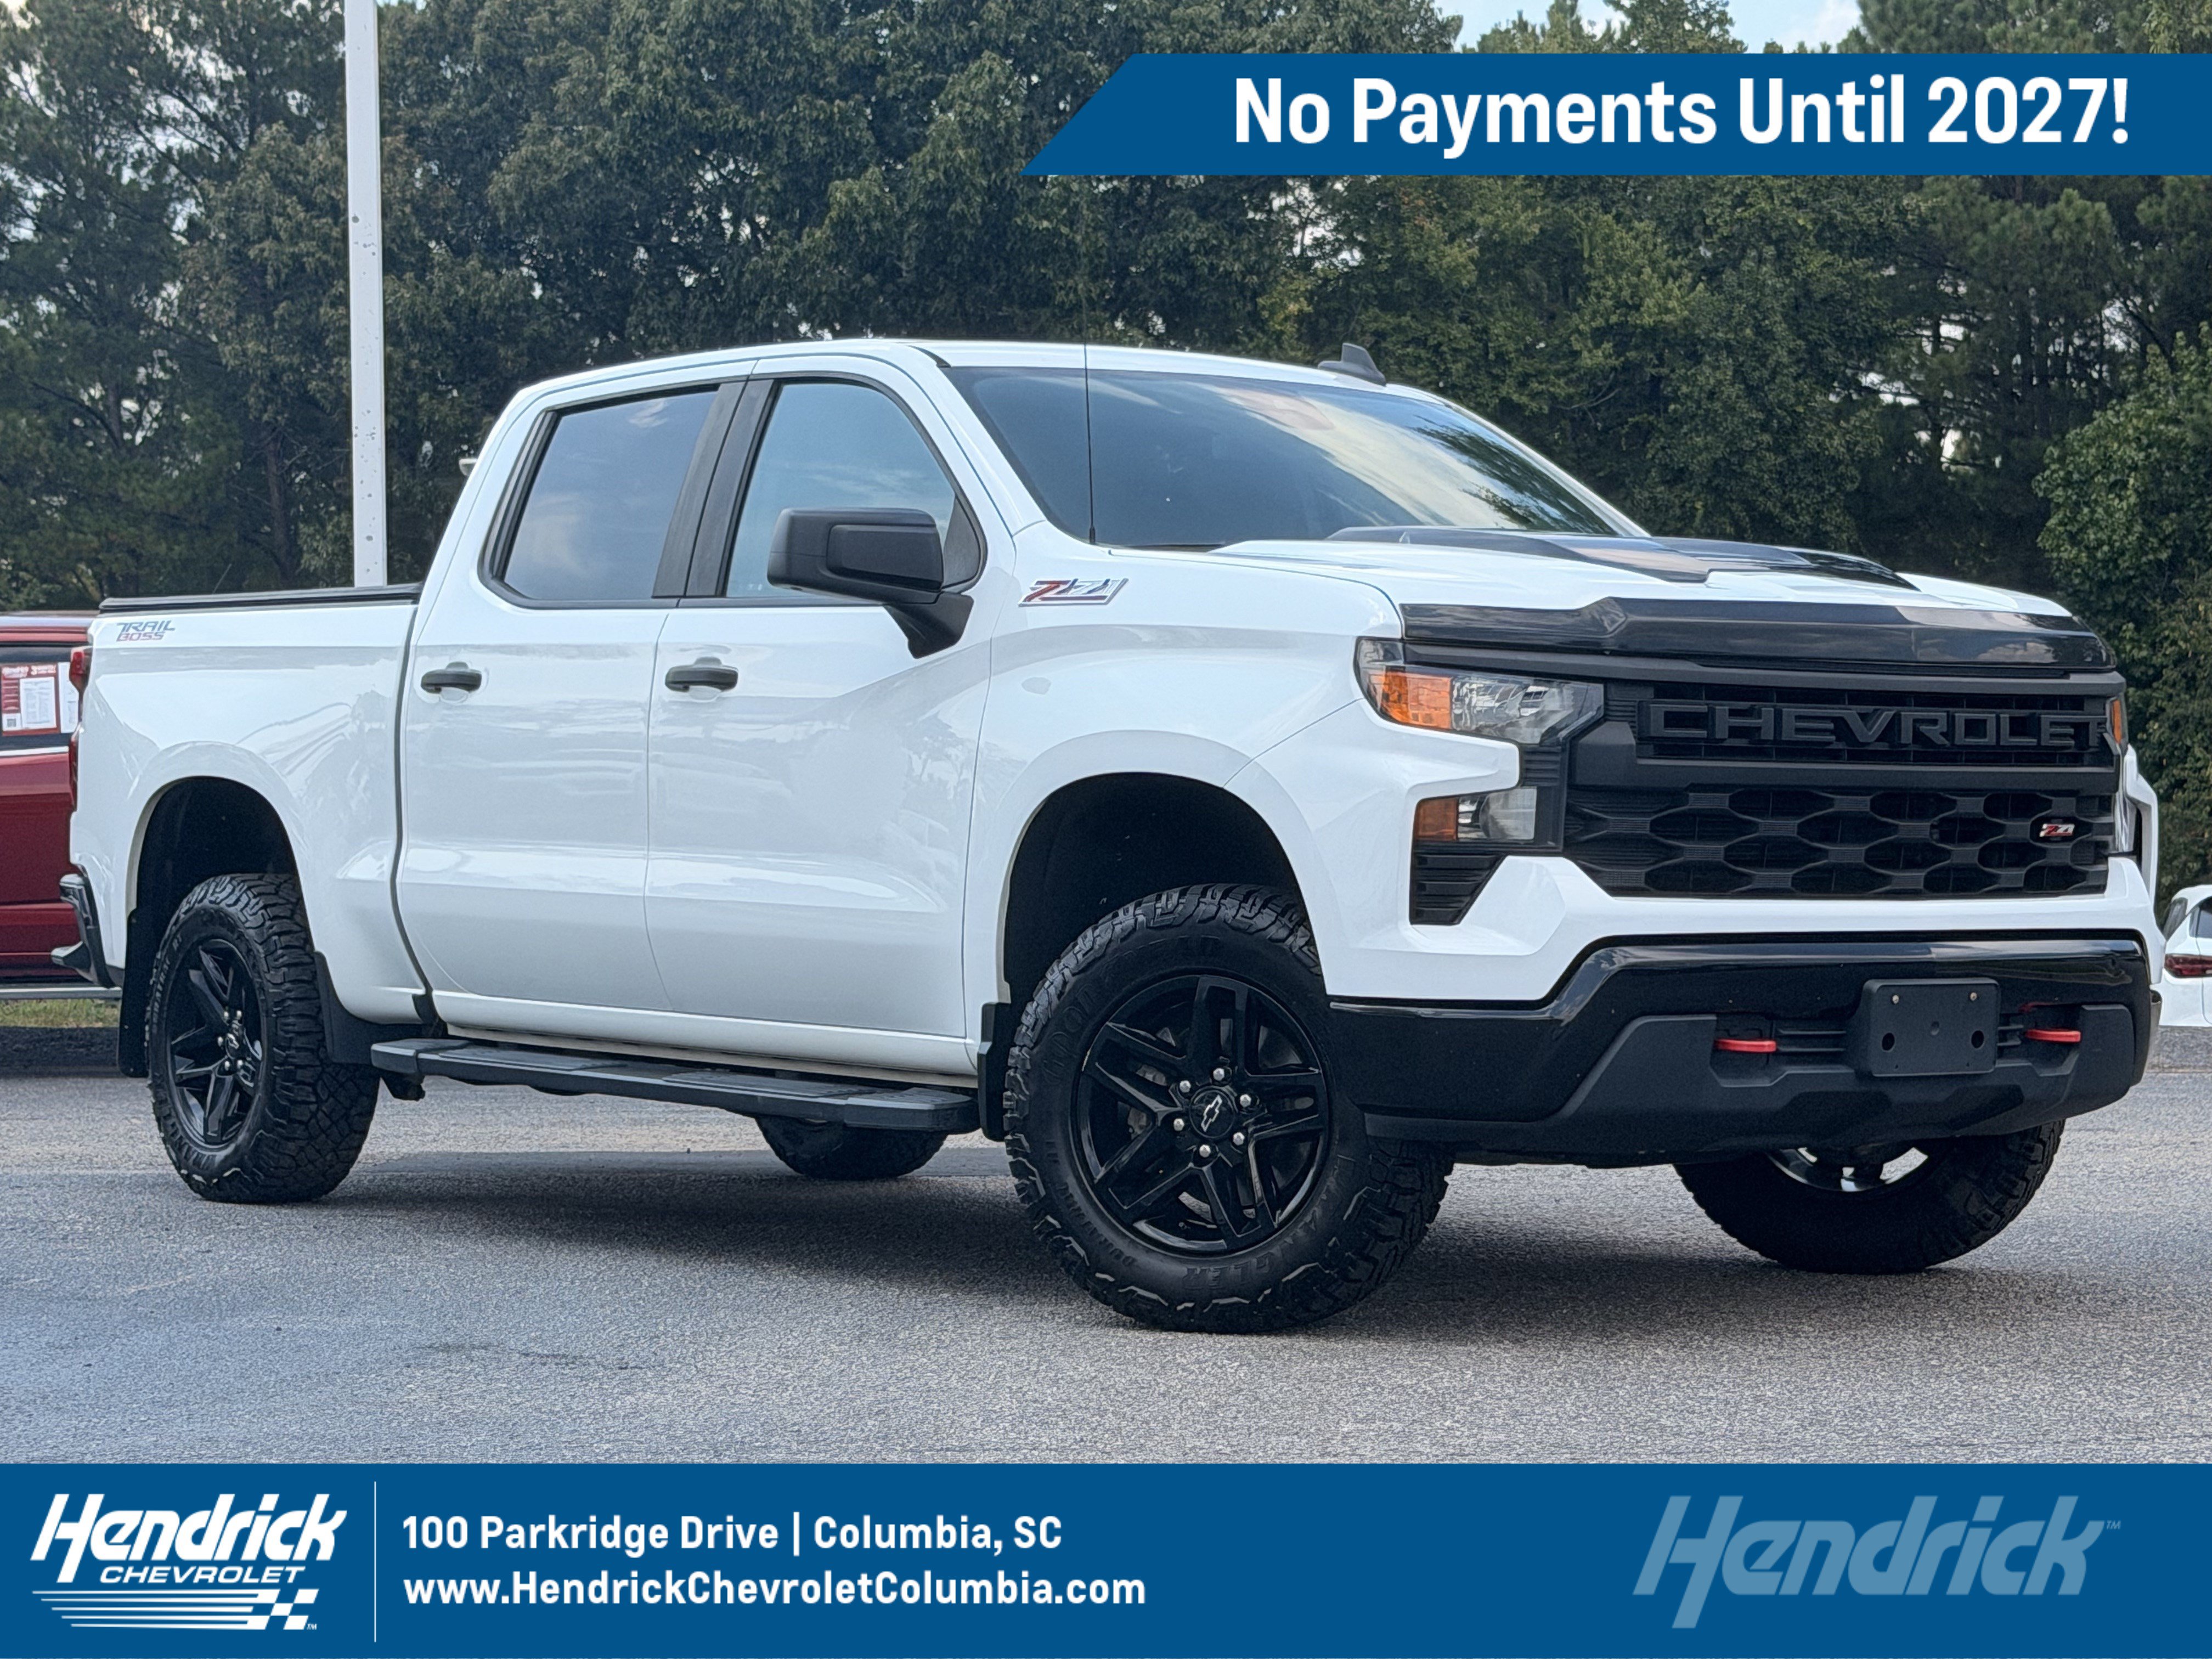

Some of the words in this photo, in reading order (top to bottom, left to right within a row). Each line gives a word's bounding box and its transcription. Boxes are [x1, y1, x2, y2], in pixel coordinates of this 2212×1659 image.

[116, 620, 175, 633] TRAIL
[116, 631, 165, 642] BOSS
[1649, 703, 2107, 746] CHEVROLET
